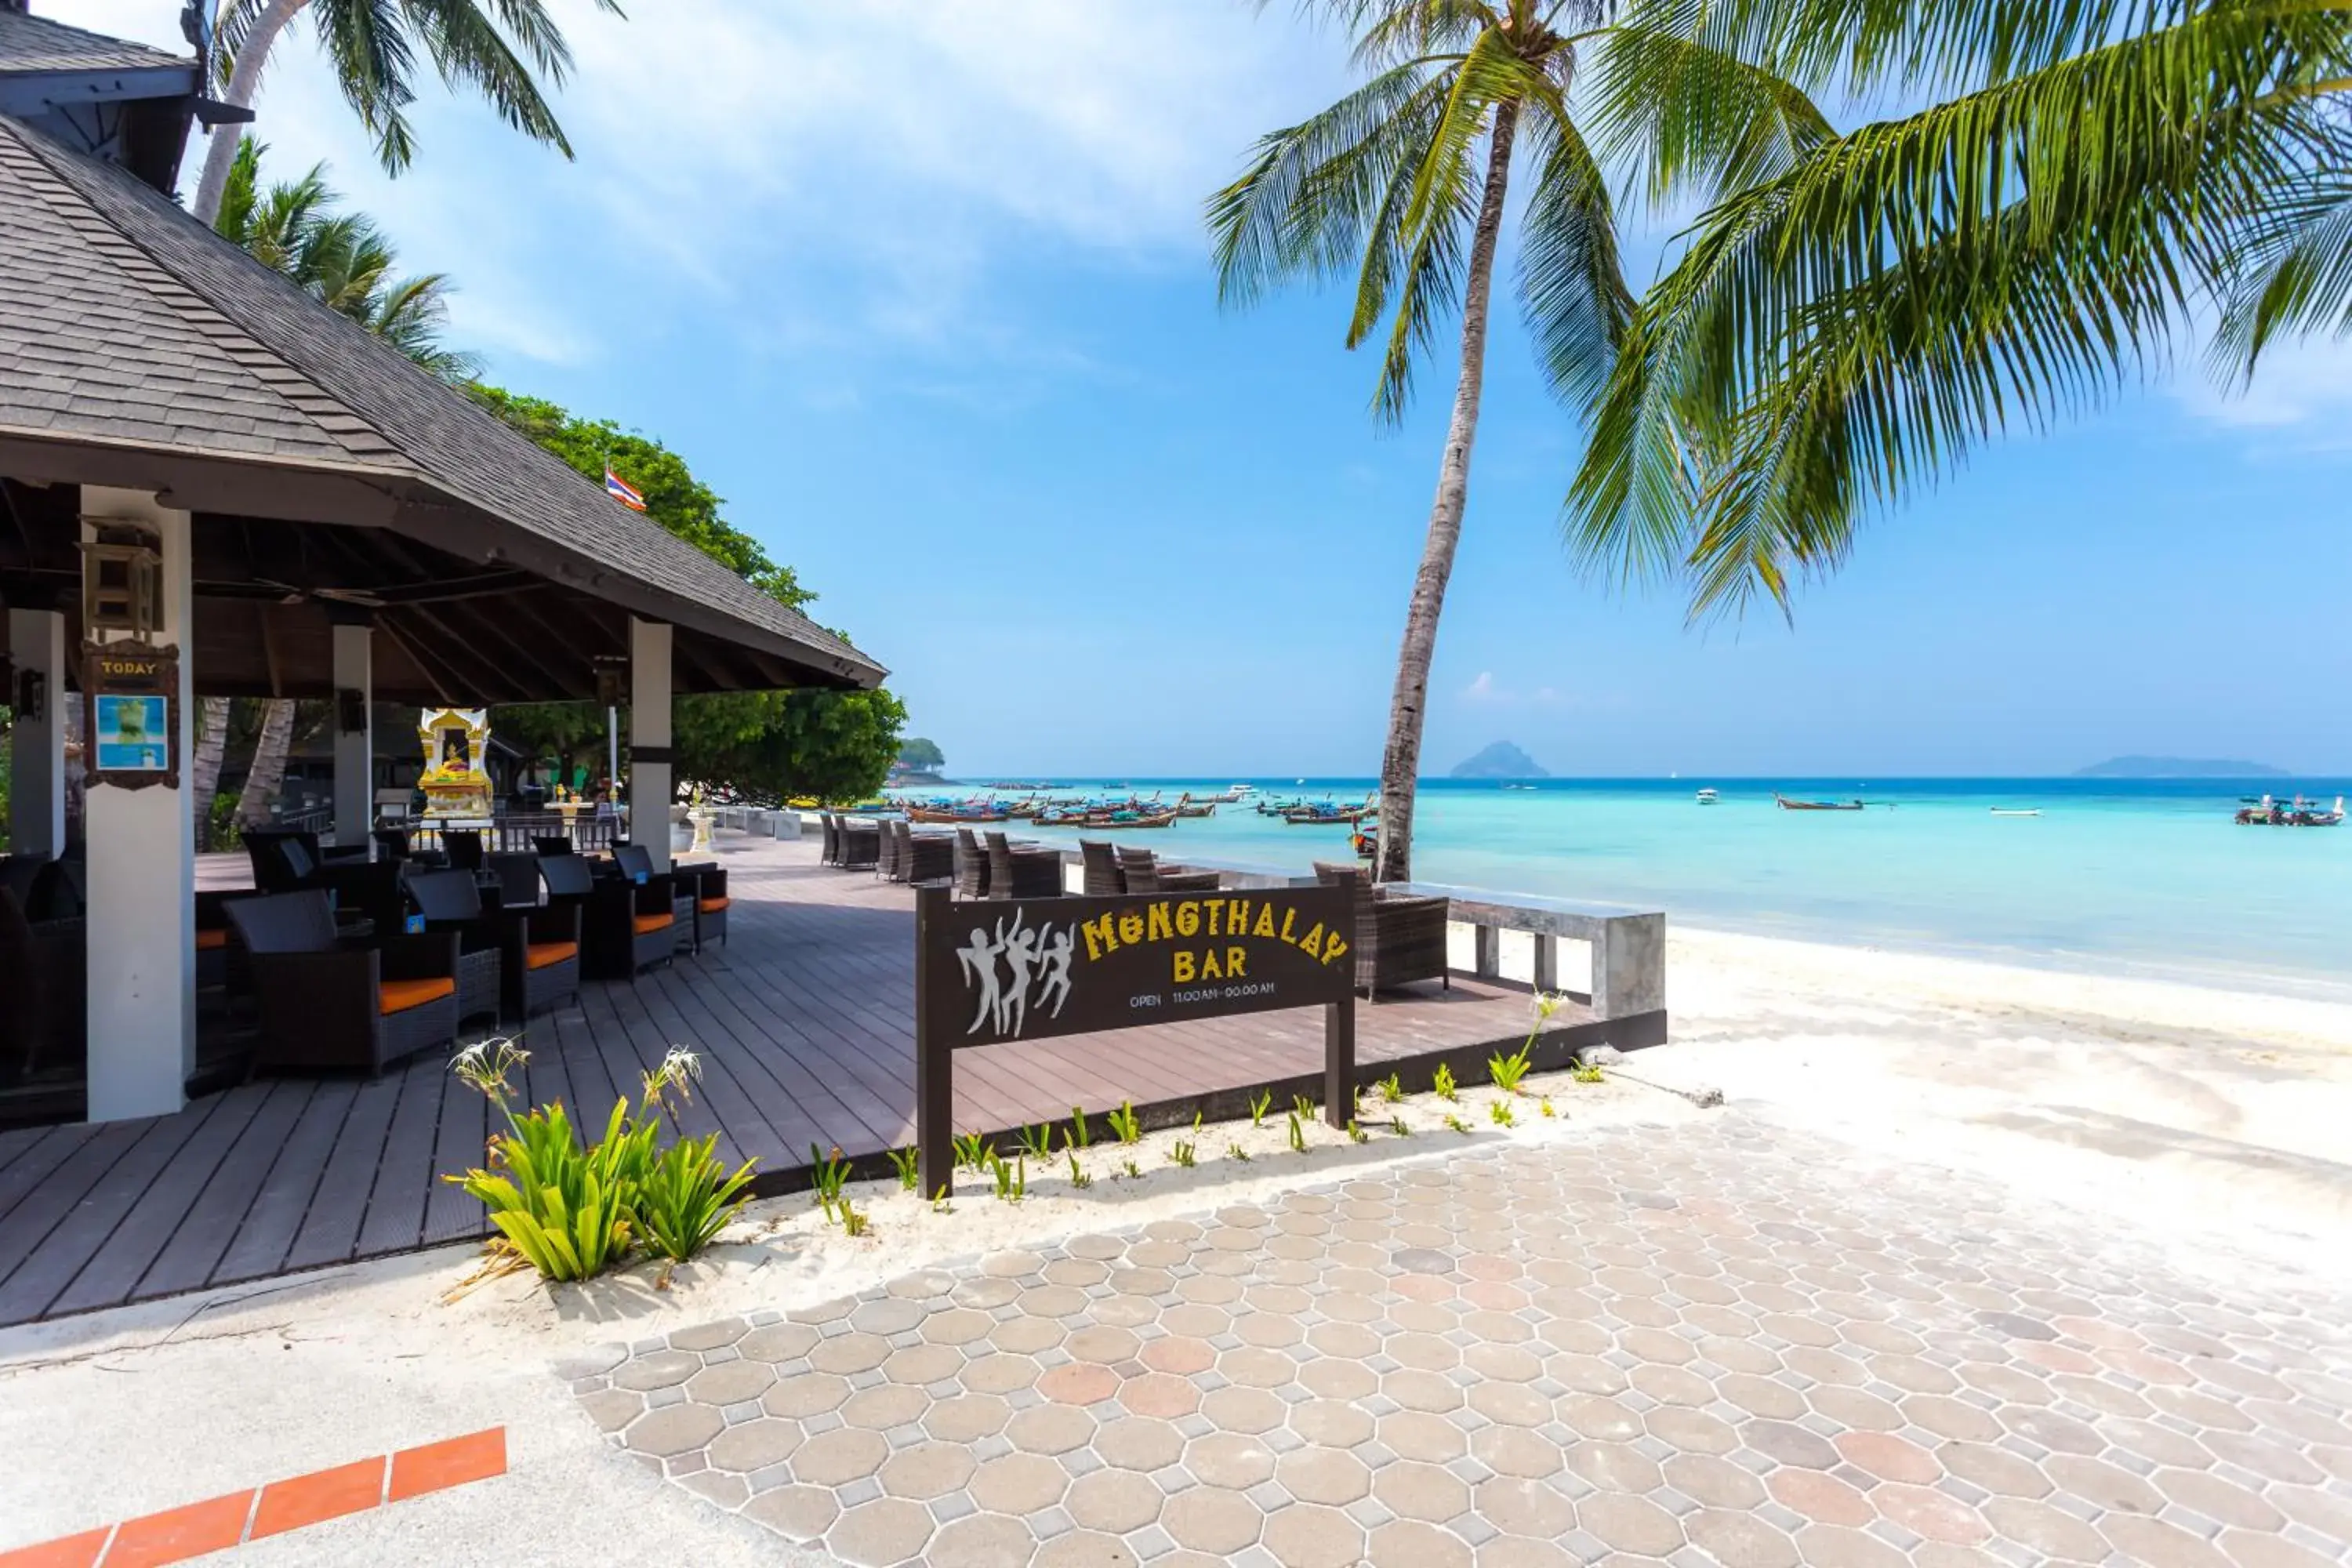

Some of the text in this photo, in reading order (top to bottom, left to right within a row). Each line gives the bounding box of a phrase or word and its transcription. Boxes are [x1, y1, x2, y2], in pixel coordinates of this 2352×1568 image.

[101, 662, 156, 674] TODAY
[1173, 946, 1247, 982] BAR
[1130, 995, 1161, 1007] OPEN
